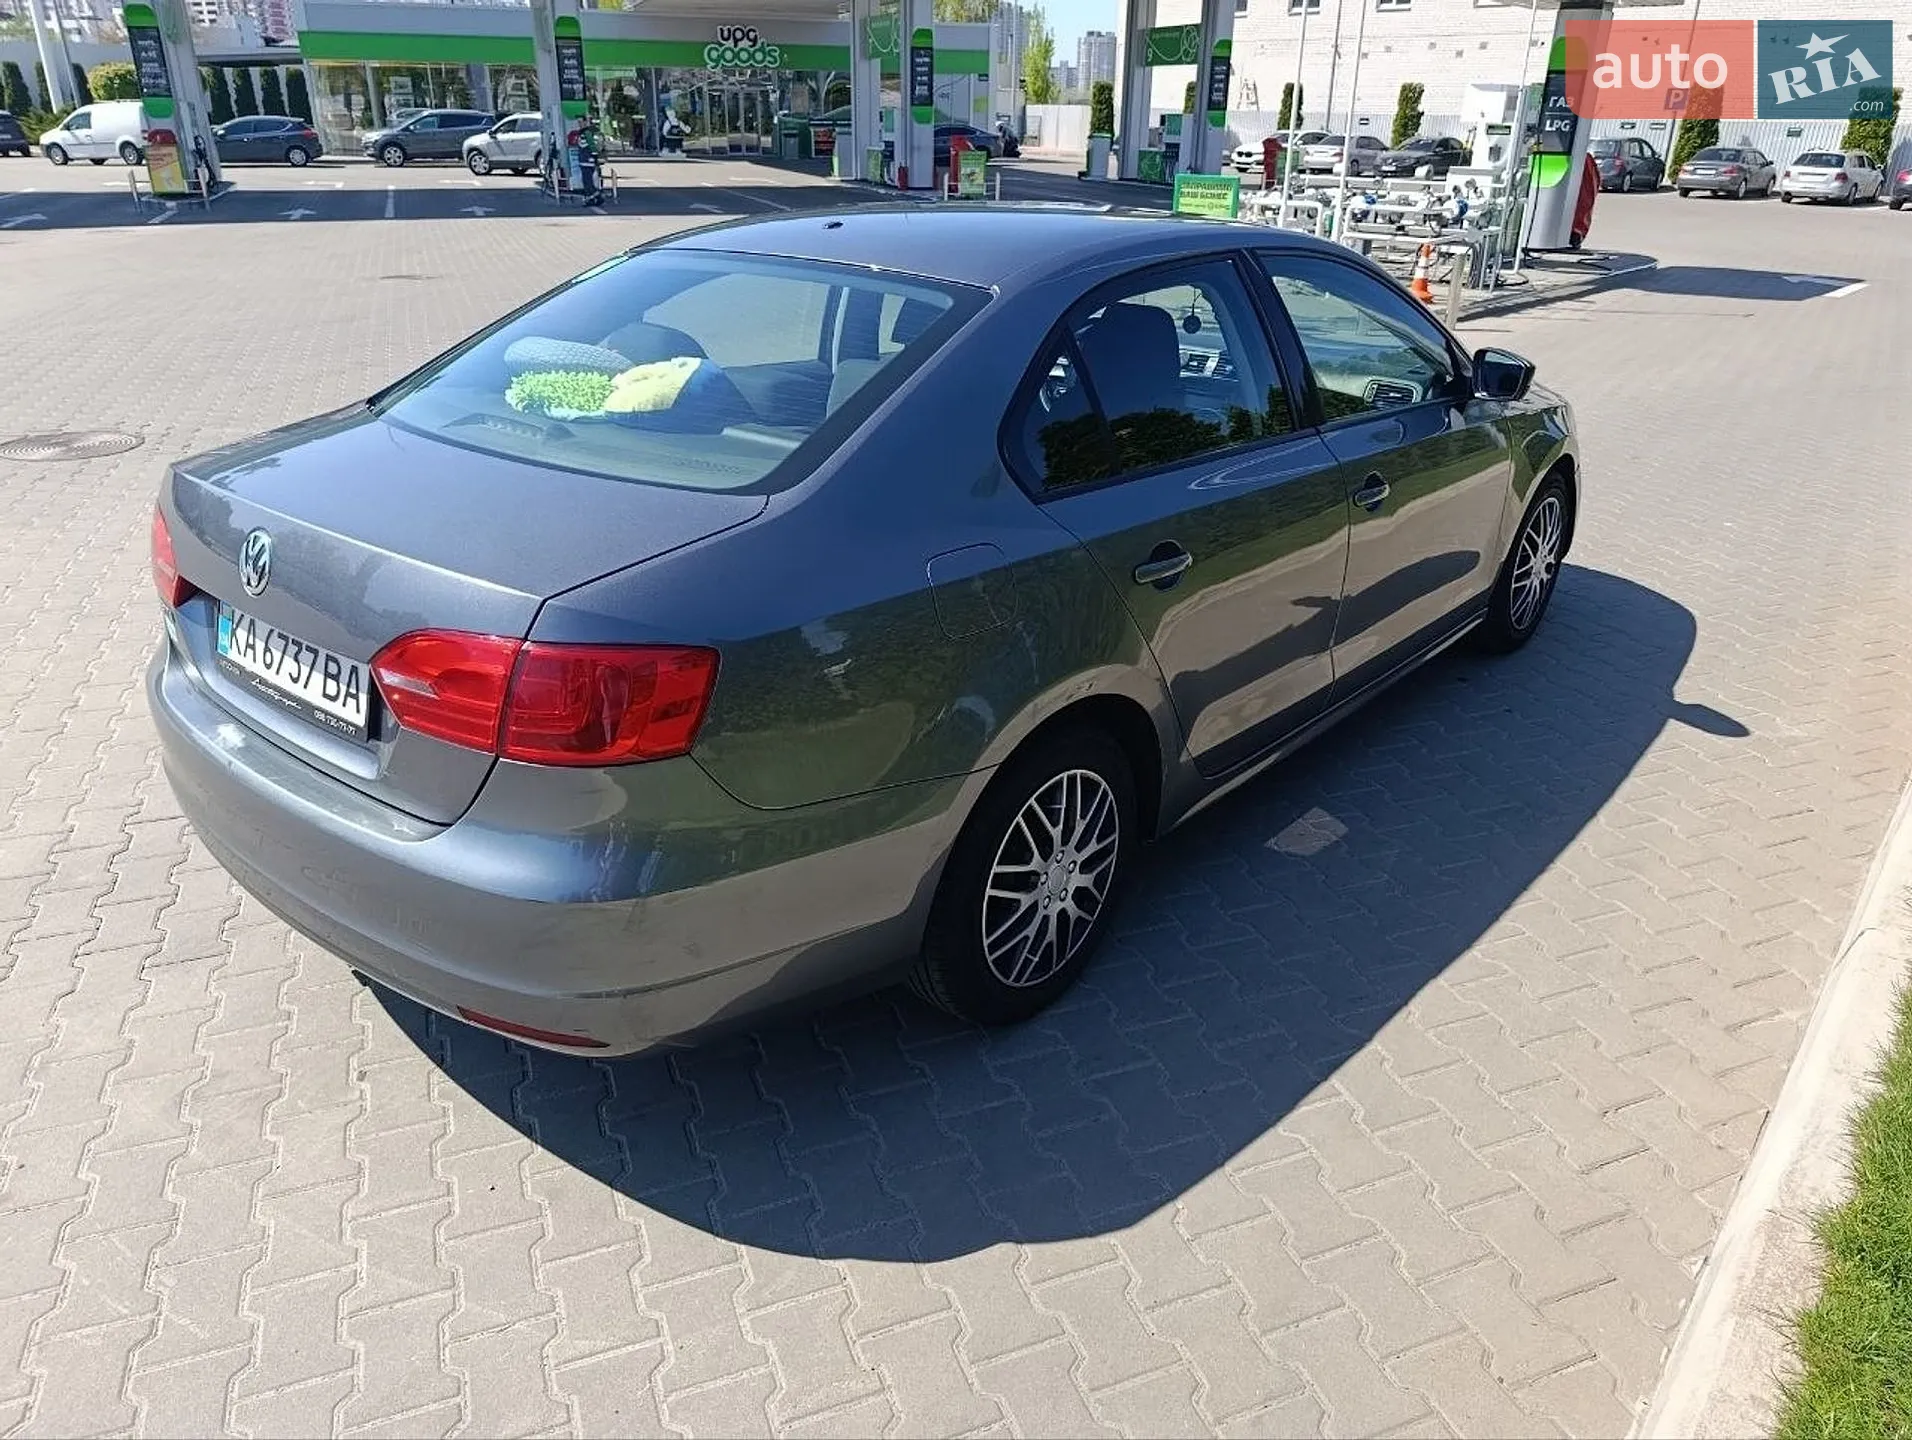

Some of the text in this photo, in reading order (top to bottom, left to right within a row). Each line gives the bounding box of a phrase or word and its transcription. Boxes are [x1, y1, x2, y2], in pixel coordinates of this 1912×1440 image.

[718, 26, 758, 48] upg
[705, 39, 779, 70] goods
[1549, 96, 1574, 107] ГАЗ
[1545, 120, 1571, 132] LPG
[230, 609, 361, 714] KA 6737 BA
